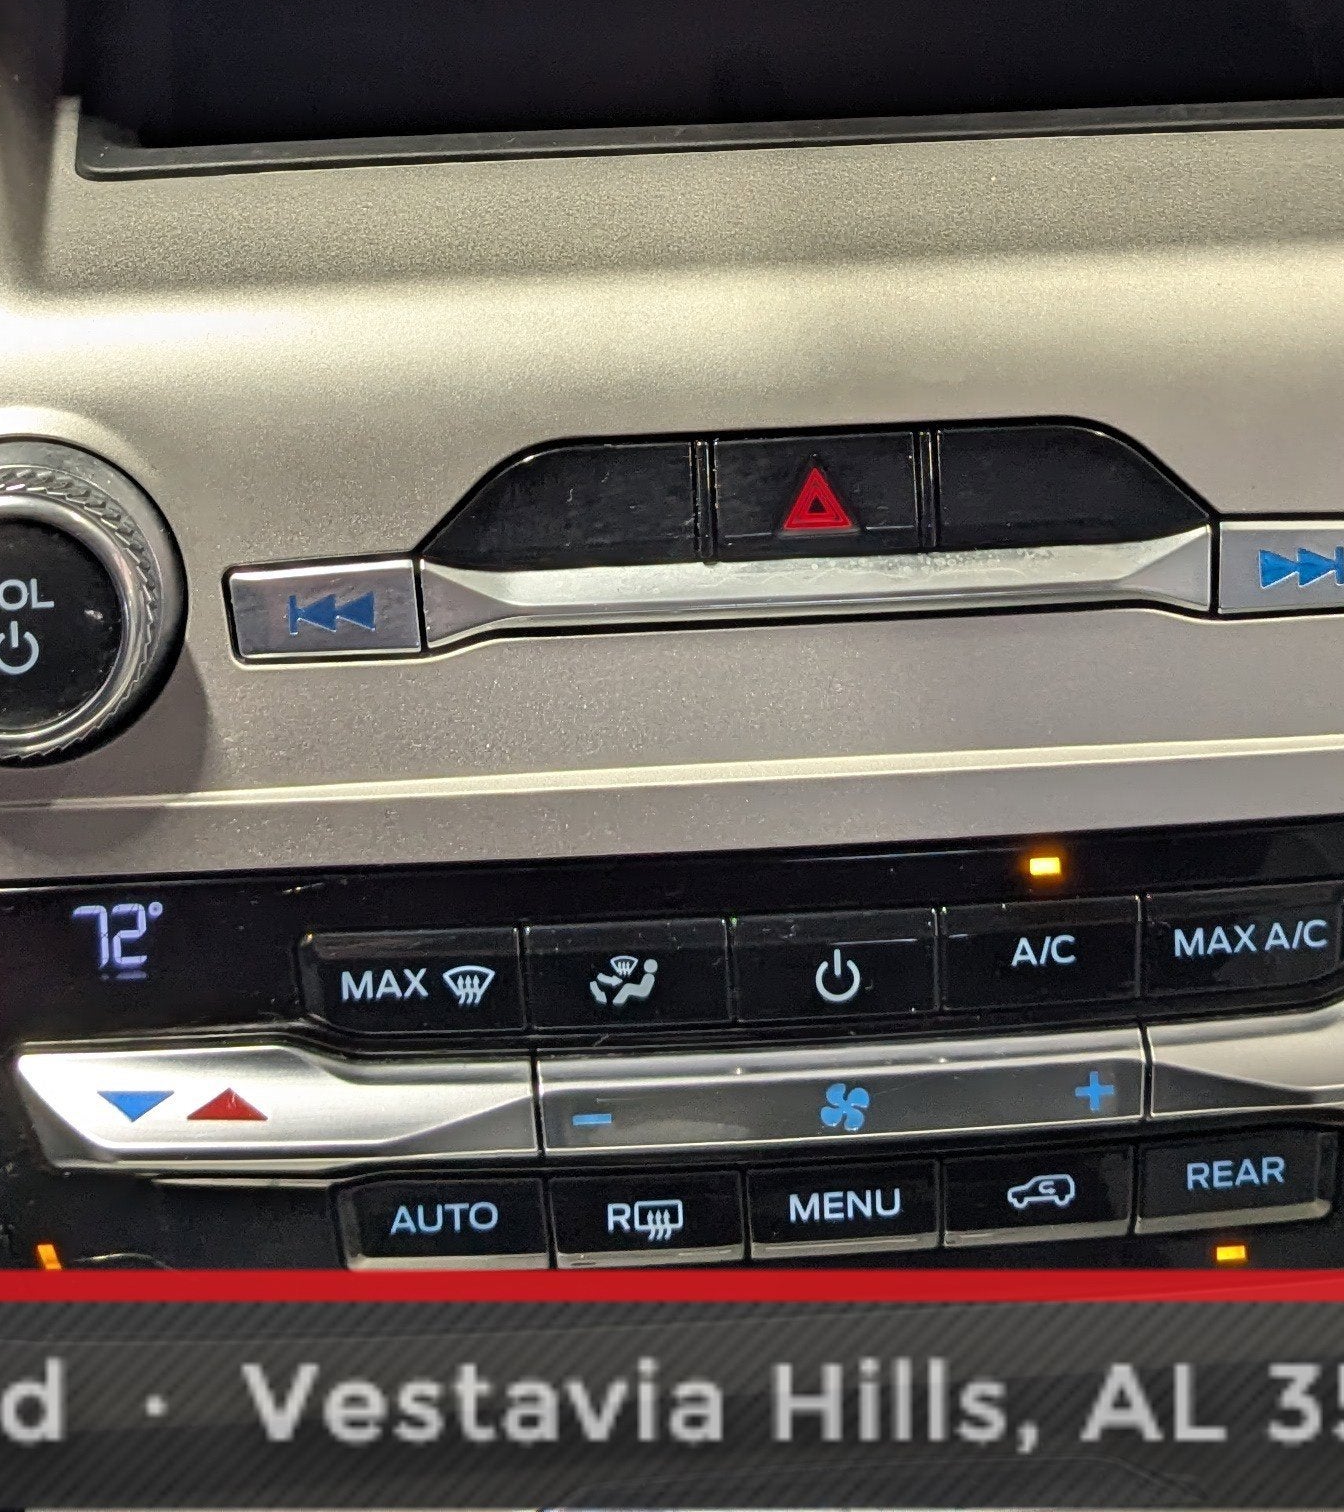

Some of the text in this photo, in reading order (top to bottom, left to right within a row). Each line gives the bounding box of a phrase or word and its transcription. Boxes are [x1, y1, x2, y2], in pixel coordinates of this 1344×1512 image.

[1011, 934, 1076, 967] A/C
[1174, 918, 1328, 957] MAX A/C
[341, 967, 428, 1002] MAX
[1187, 1156, 1286, 1190] REAR
[390, 1201, 499, 1235] AUTO
[789, 1188, 902, 1223] MENU
